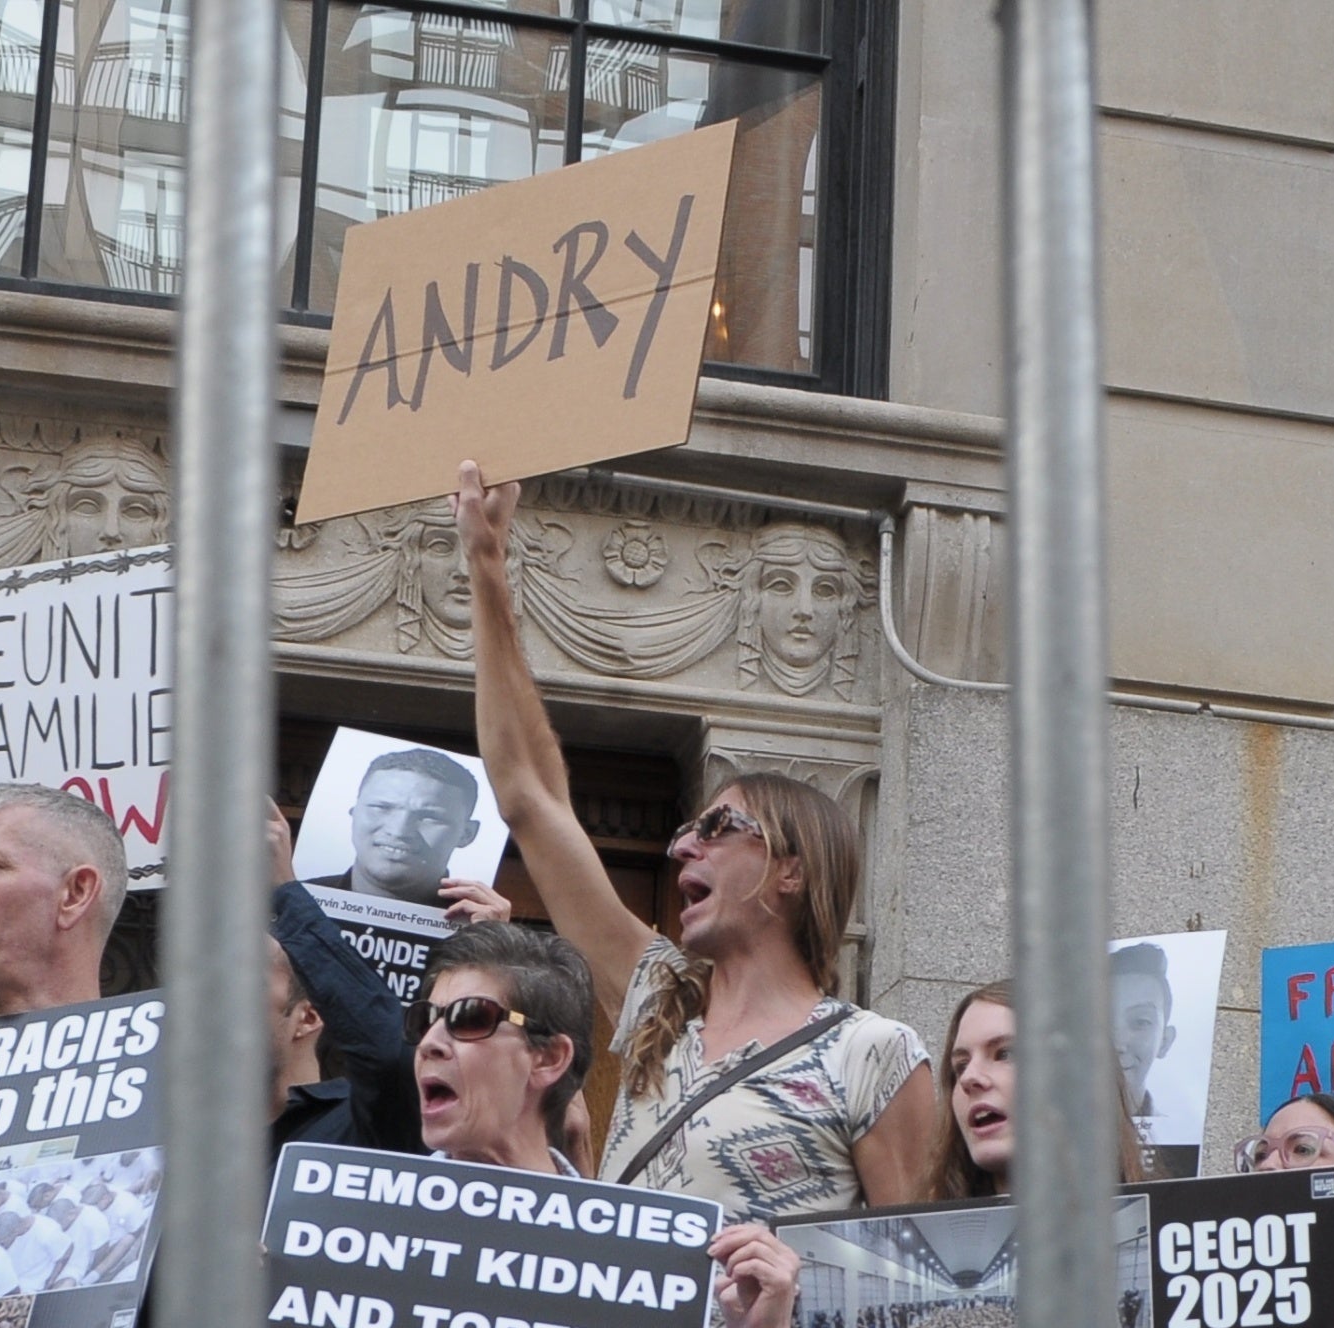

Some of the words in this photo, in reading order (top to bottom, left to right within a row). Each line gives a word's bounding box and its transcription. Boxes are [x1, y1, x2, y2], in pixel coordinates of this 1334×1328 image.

[337, 194, 695, 425] ANDRY
[313, 896, 339, 910] ervin
[341, 901, 364, 914] Jose
[25, 1063, 148, 1132] this
[292, 1158, 709, 1249] DEMOCRACIES
[1158, 1212, 1316, 1274] CECOT
[282, 1219, 462, 1278] DON'T
[475, 1246, 698, 1311] KIDNAP
